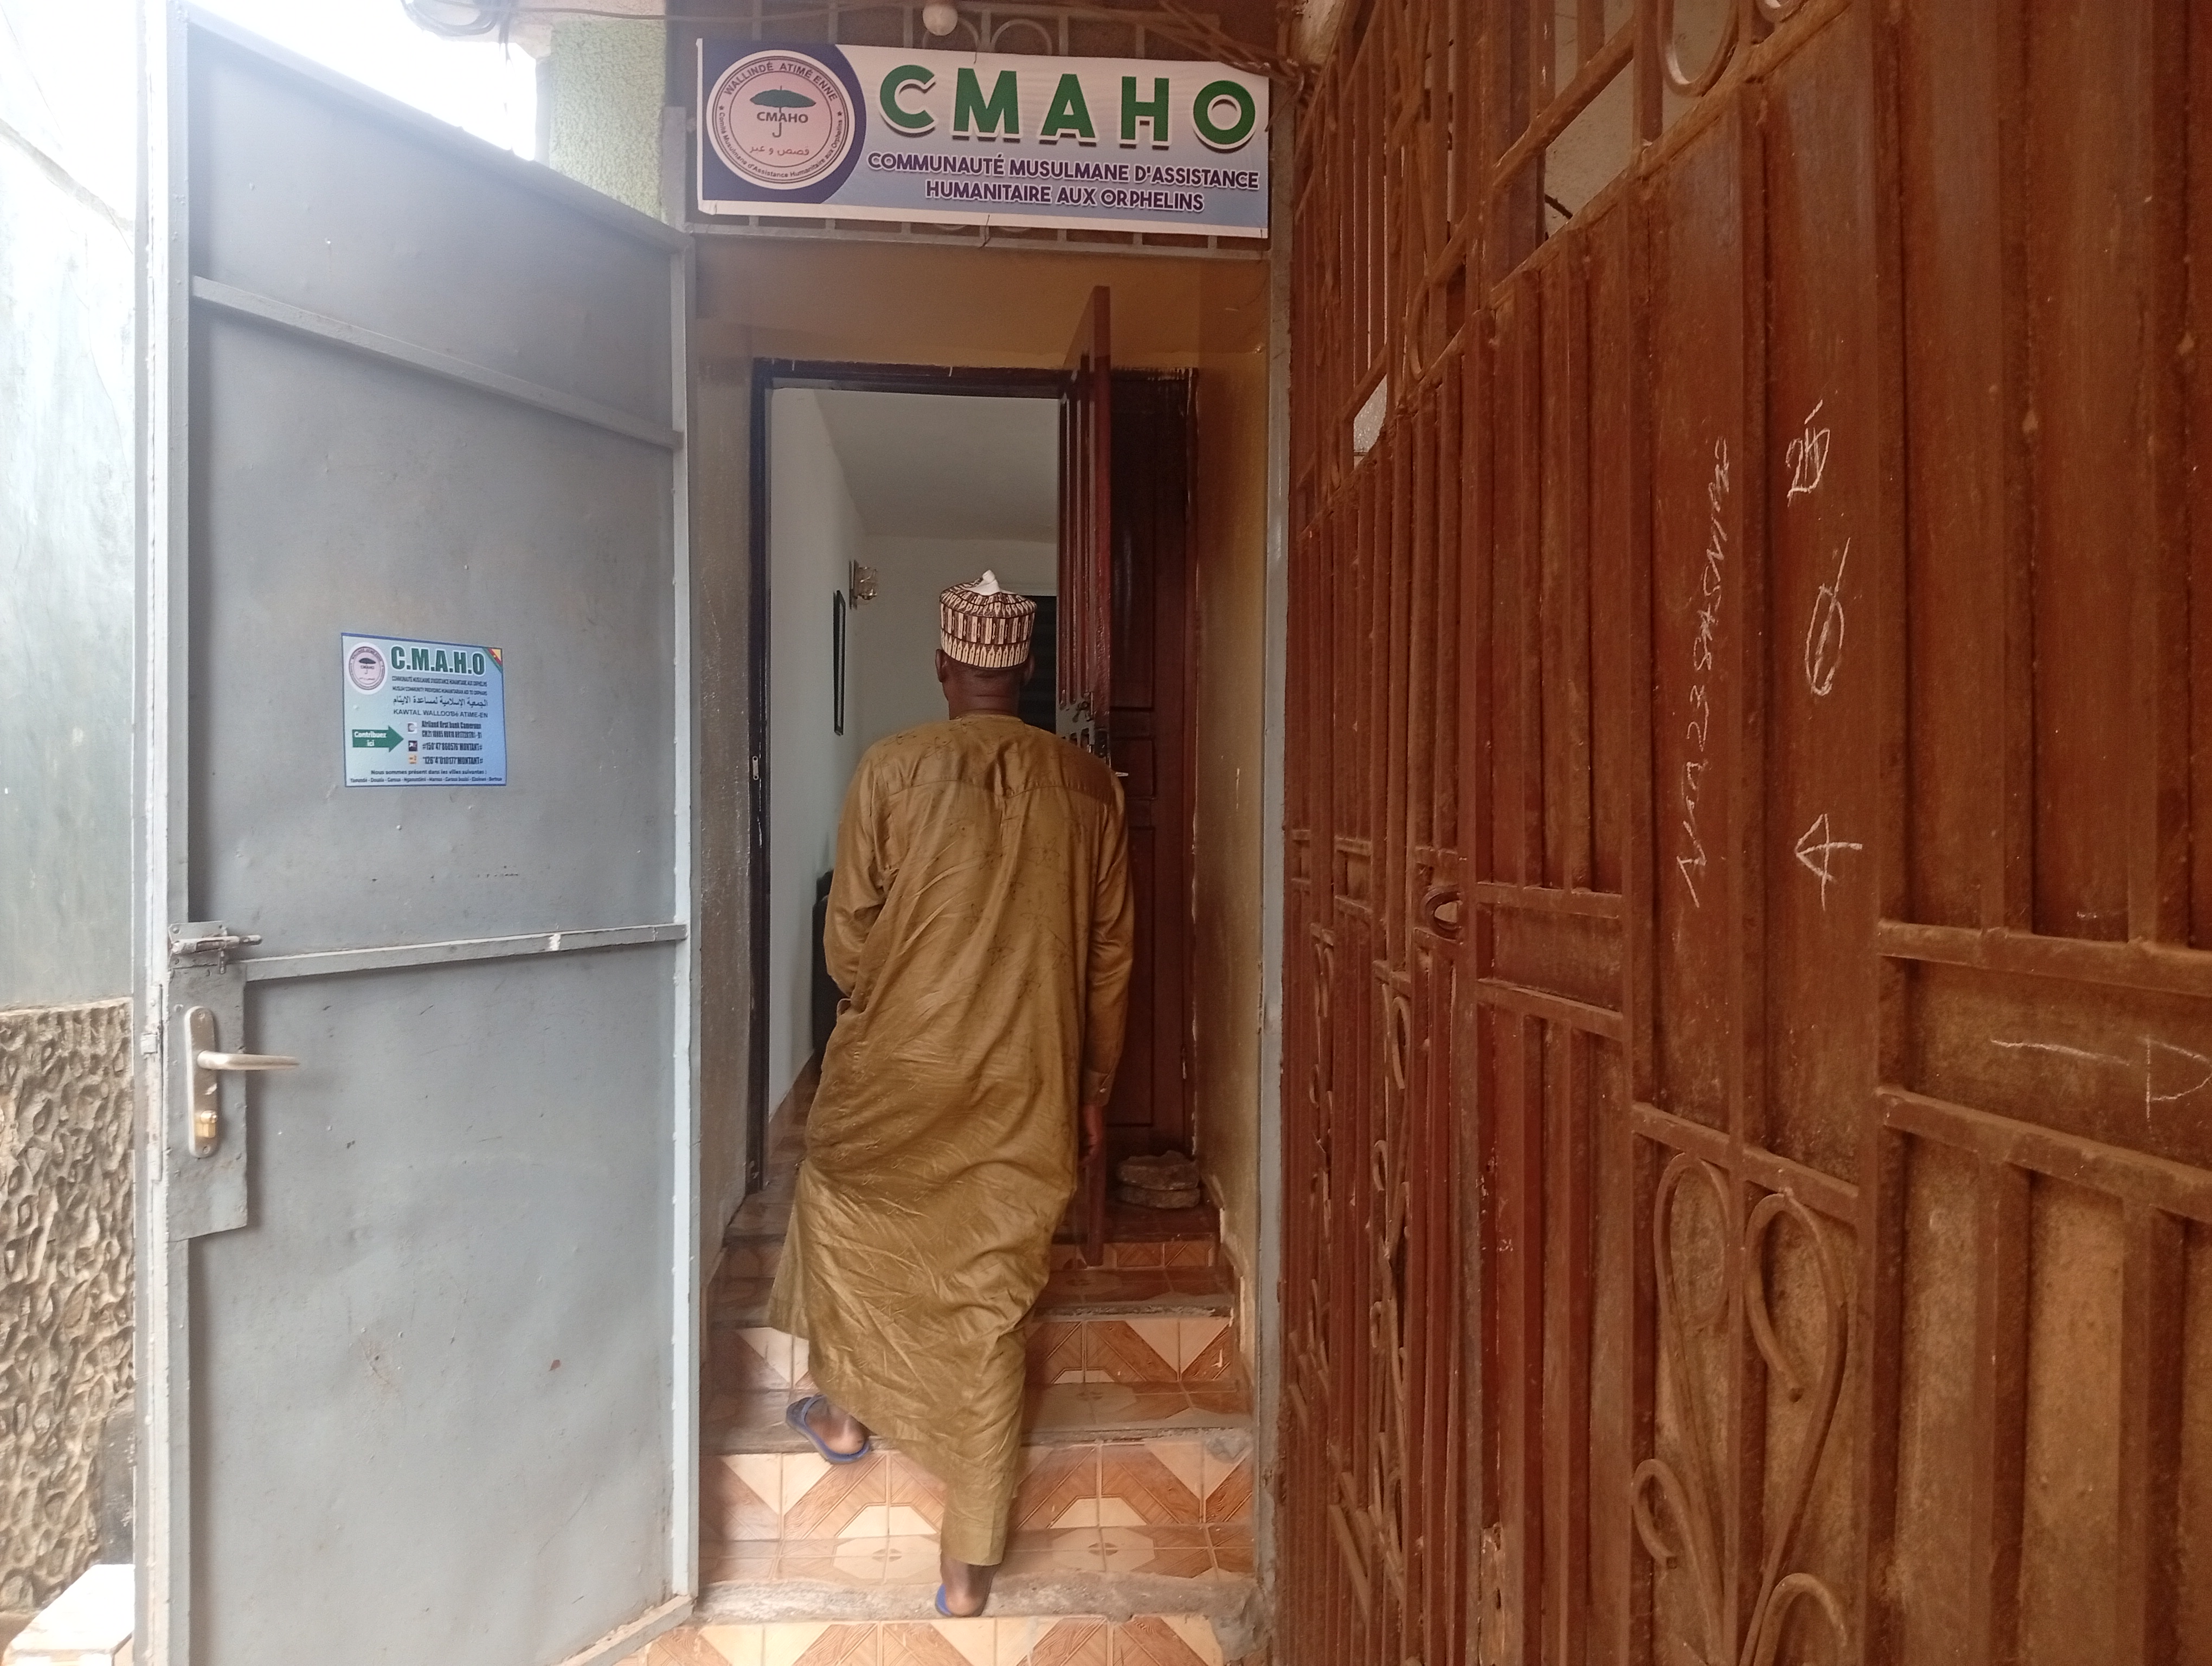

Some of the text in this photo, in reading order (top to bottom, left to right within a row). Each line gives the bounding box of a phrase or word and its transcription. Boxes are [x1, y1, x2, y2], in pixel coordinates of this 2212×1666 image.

[724, 61, 838, 102] WALLINDÉ ATIMÉ ENNE
[757, 111, 809, 124] CMAHO
[878, 63, 1258, 148] CMAHO
[723, 134, 747, 165] Musulmane
[748, 162, 789, 178] d'Assistance
[790, 158, 826, 177] Humanitaire
[867, 152, 1259, 189] COMMUNAUTÉ MUSULMANE D'ASSISTANCE
[926, 180, 1204, 211] HUMANITAIRE AUX ORPHELINS
[391, 646, 485, 676] C.M.A.H.O
